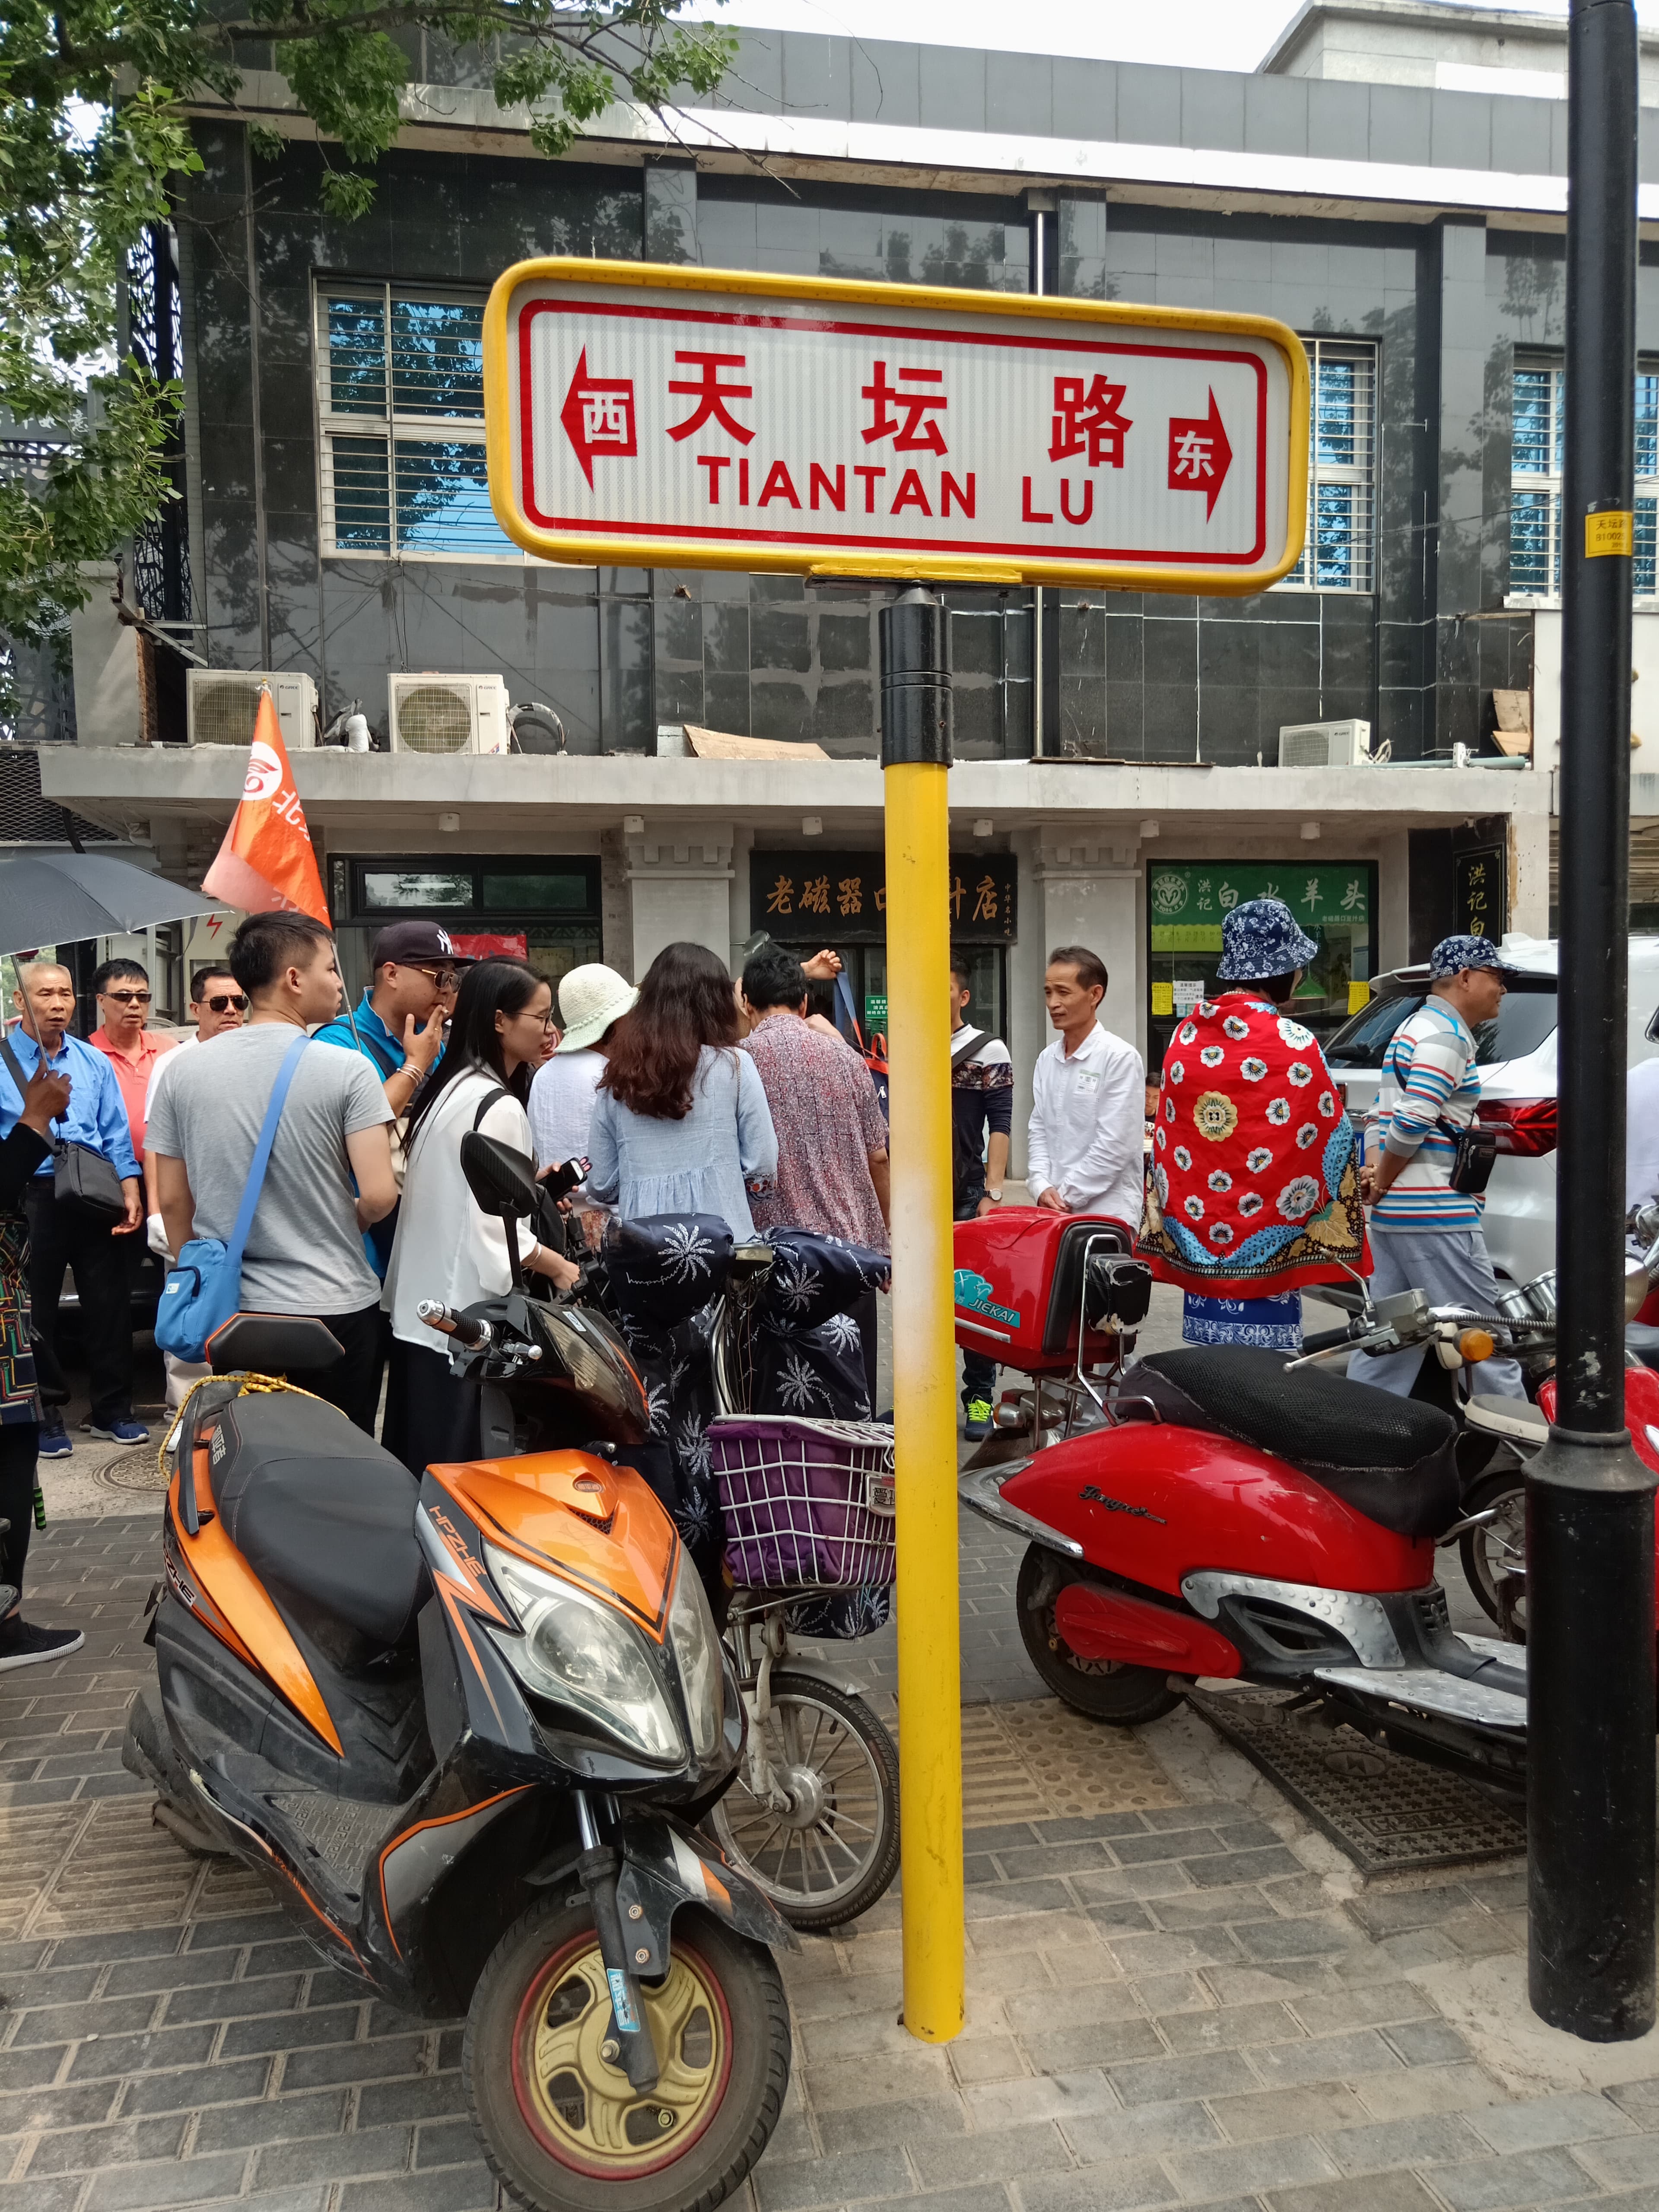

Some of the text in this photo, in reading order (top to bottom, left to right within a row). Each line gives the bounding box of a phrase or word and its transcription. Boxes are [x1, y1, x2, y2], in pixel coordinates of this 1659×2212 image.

[578, 391, 630, 445] 西
[666, 350, 1133, 468] 天坛路
[1173, 431, 1214, 480] 东
[697, 455, 1093, 525] TIANTAN LU
[1004, 883, 1012, 937] 中华名小吃
[1196, 878, 1213, 911] 洪记
[1218, 878, 1366, 912] 白水羊头
[1467, 862, 1487, 937] 洪记白
[969, 1298, 1015, 1323] JIEKAI
[429, 1506, 487, 1577] HPZHE
